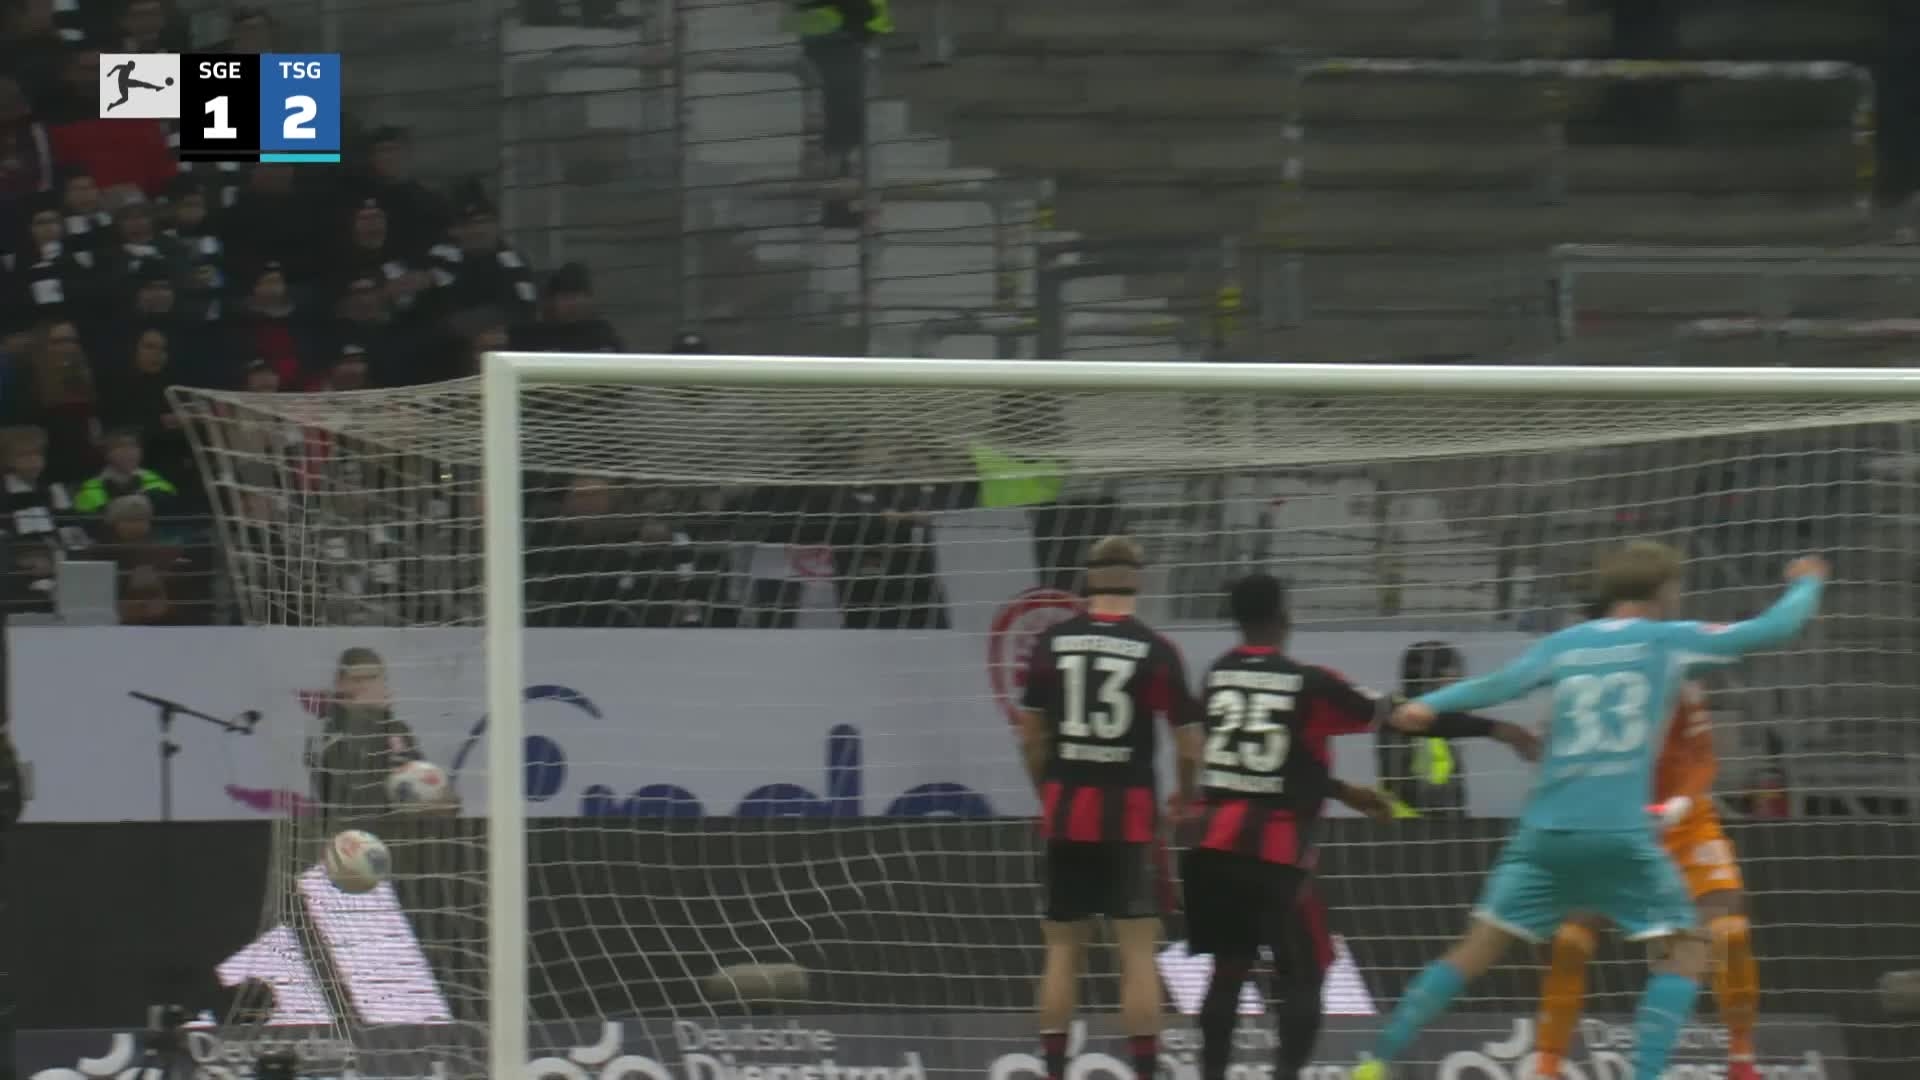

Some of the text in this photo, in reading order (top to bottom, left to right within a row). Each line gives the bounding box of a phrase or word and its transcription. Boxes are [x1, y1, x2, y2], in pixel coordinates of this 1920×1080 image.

[1056, 654, 1138, 739] 13
[1203, 690, 1297, 772] 25
[1552, 671, 1650, 756] 33
